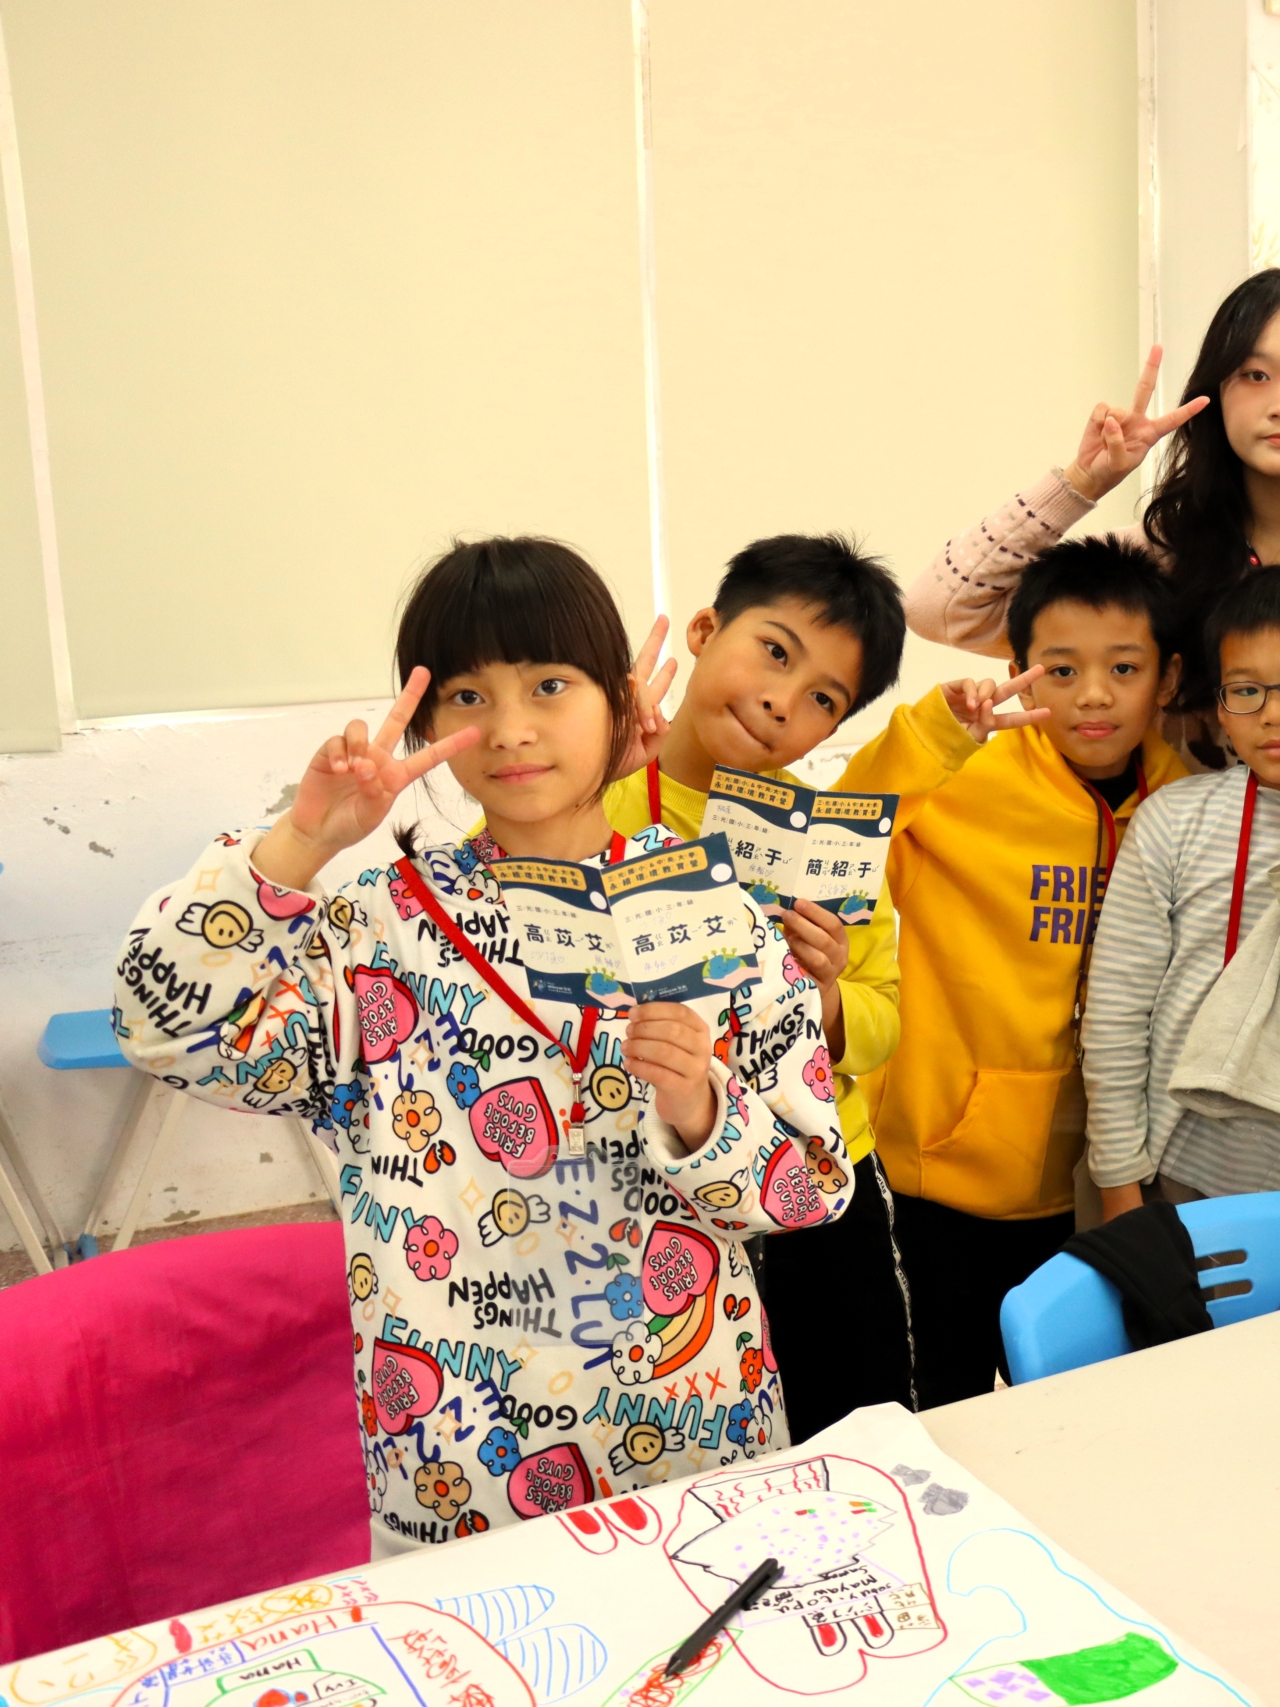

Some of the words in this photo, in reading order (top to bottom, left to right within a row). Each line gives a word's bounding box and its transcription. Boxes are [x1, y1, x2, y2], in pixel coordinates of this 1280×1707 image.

[724, 836, 783, 867] 紹于
[632, 915, 727, 956] 高苡艾
[128, 927, 212, 1015] HAPPEN
[117, 957, 192, 1038] THINGS
[367, 1015, 399, 1047] RIES
[457, 1027, 540, 1063] GOOD
[731, 1002, 805, 1057] THINGS
[484, 1103, 536, 1144] BEFORE
[497, 1090, 538, 1123] GUYS
[483, 1122, 526, 1159] FRIES
[611, 1162, 669, 1192] INGS
[773, 1177, 796, 1222] GUYS
[648, 1237, 683, 1272] GUYS
[649, 1248, 695, 1291] BEFORE
[449, 1267, 556, 1308] HAPPEN
[662, 1264, 699, 1302] FRIES
[473, 1302, 563, 1339] THINGS
[375, 1355, 398, 1387] GUYS
[378, 1368, 413, 1407] BEFORE
[386, 1384, 420, 1420] FRIES
[500, 1394, 578, 1431] GOOD
[583, 1387, 728, 1450] FUNNY
[525, 1467, 574, 1500] BEFORE
[537, 1457, 575, 1481] GUYS
